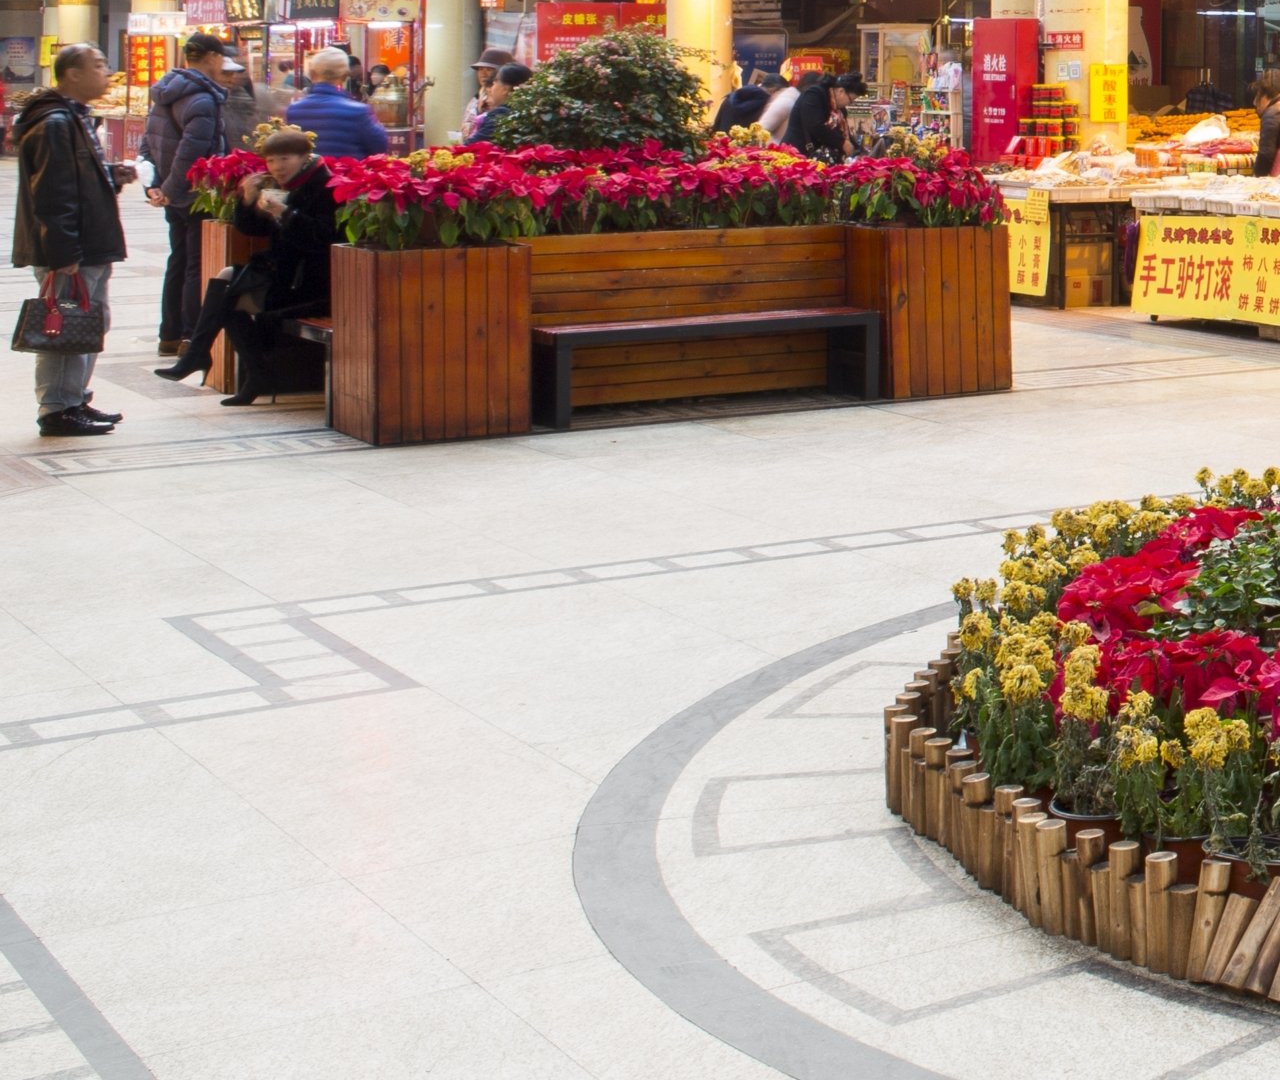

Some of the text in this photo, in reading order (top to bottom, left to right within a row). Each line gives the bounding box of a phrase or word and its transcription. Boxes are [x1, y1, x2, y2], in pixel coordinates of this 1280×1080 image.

[983, 55, 1006, 71] 消火栓
[1103, 79, 1117, 120] 酸枣面
[1139, 253, 1234, 302] 手工驴打滚
